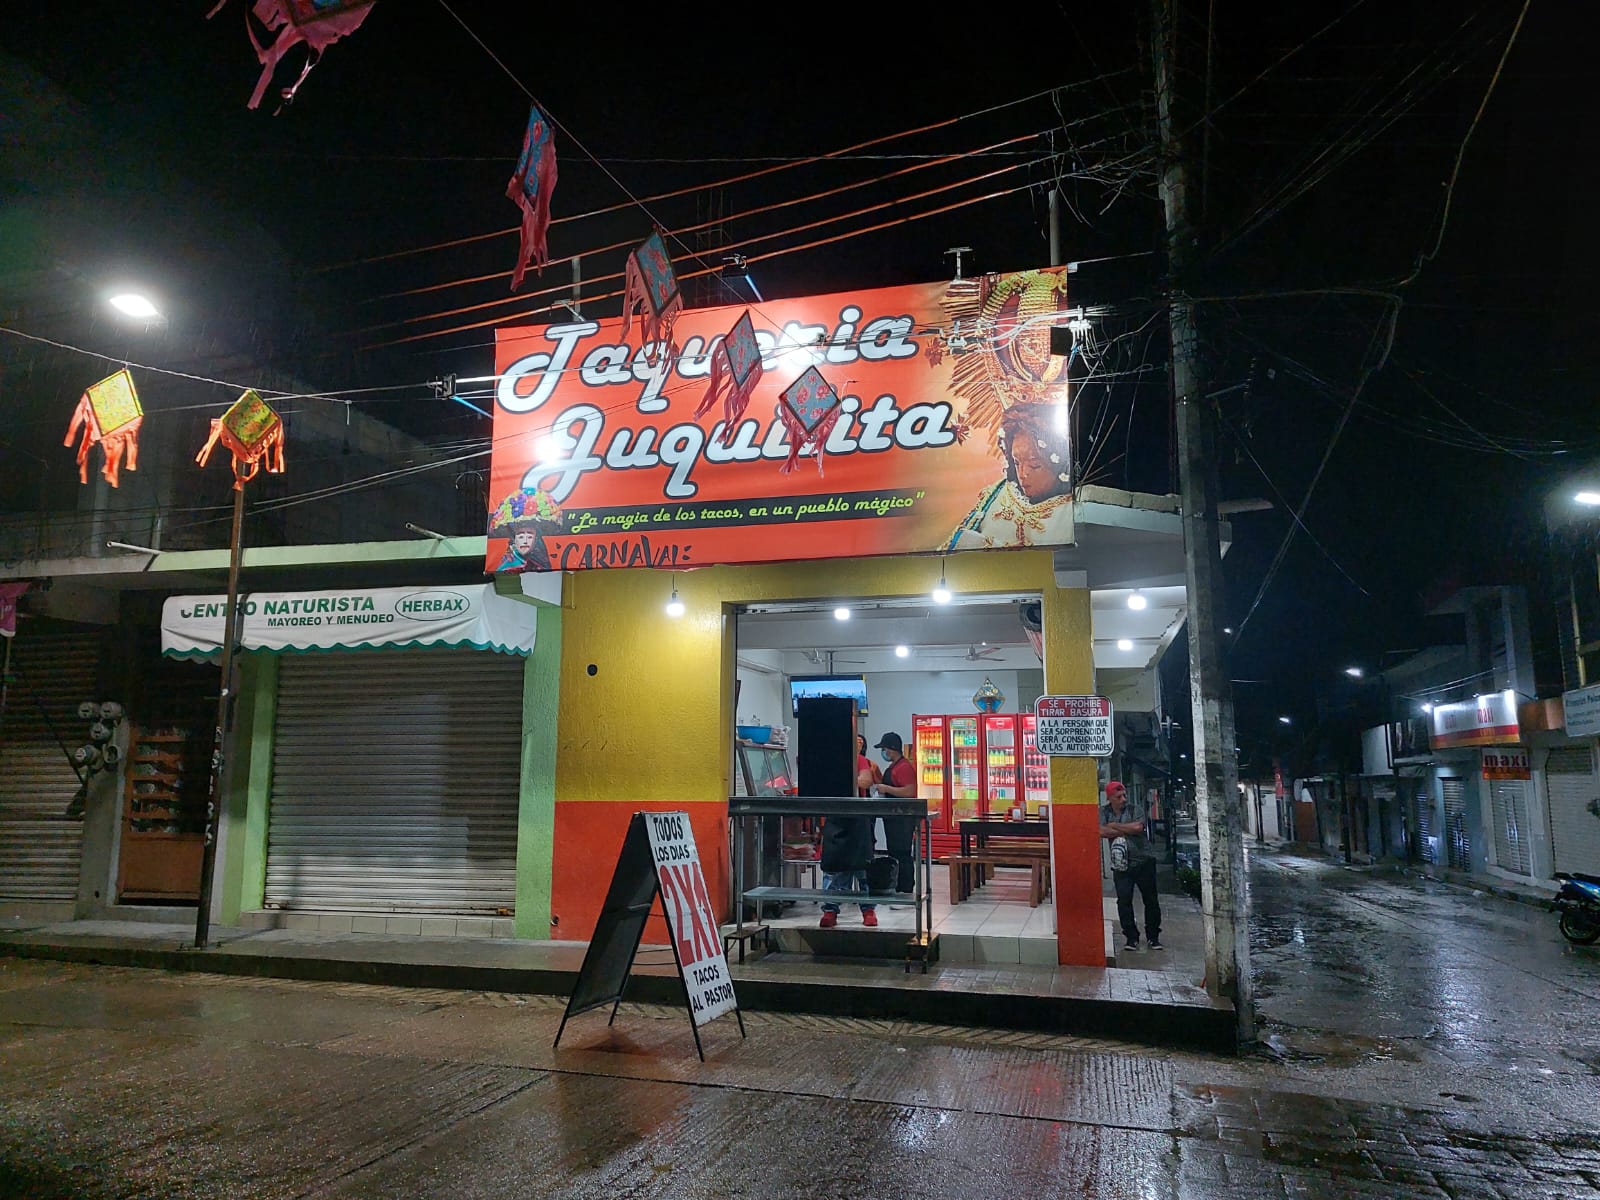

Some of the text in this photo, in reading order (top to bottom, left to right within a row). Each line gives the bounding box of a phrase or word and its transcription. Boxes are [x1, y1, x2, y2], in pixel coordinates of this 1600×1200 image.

[520, 393, 957, 505] Juquiita
[602, 511, 649, 530] magia
[653, 507, 671, 522] de
[675, 506, 696, 521] los
[700, 508, 744, 520] tacos,
[749, 505, 768, 517] en
[772, 504, 794, 516] un
[794, 497, 850, 521] pueblo
[263, 596, 375, 616] NATURISTA
[401, 598, 463, 613] HERBAX
[267, 613, 395, 628] MAYOREO Y MENUDEO
[1048, 699, 1102, 708] SE PROHIBE
[1041, 708, 1103, 717] TIRAR BASURA
[1040, 719, 1046, 728] A
[1048, 719, 1059, 728] LA
[1062, 719, 1094, 728] PERSONA
[1095, 719, 1109, 728] QUE
[1040, 727, 1107, 736] SEA SORPRENDIDA
[1061, 735, 1106, 744] CONSIGNADA
[1041, 743, 1047, 752] A
[1049, 743, 1064, 752] LAS
[1484, 752, 1528, 767] maxi
[653, 815, 684, 842] TODOS
[655, 844, 690, 863] LOS DIAS
[659, 861, 721, 967] 2X1
[693, 964, 720, 985] TACOS
[692, 982, 734, 1013] AL PASTOR
